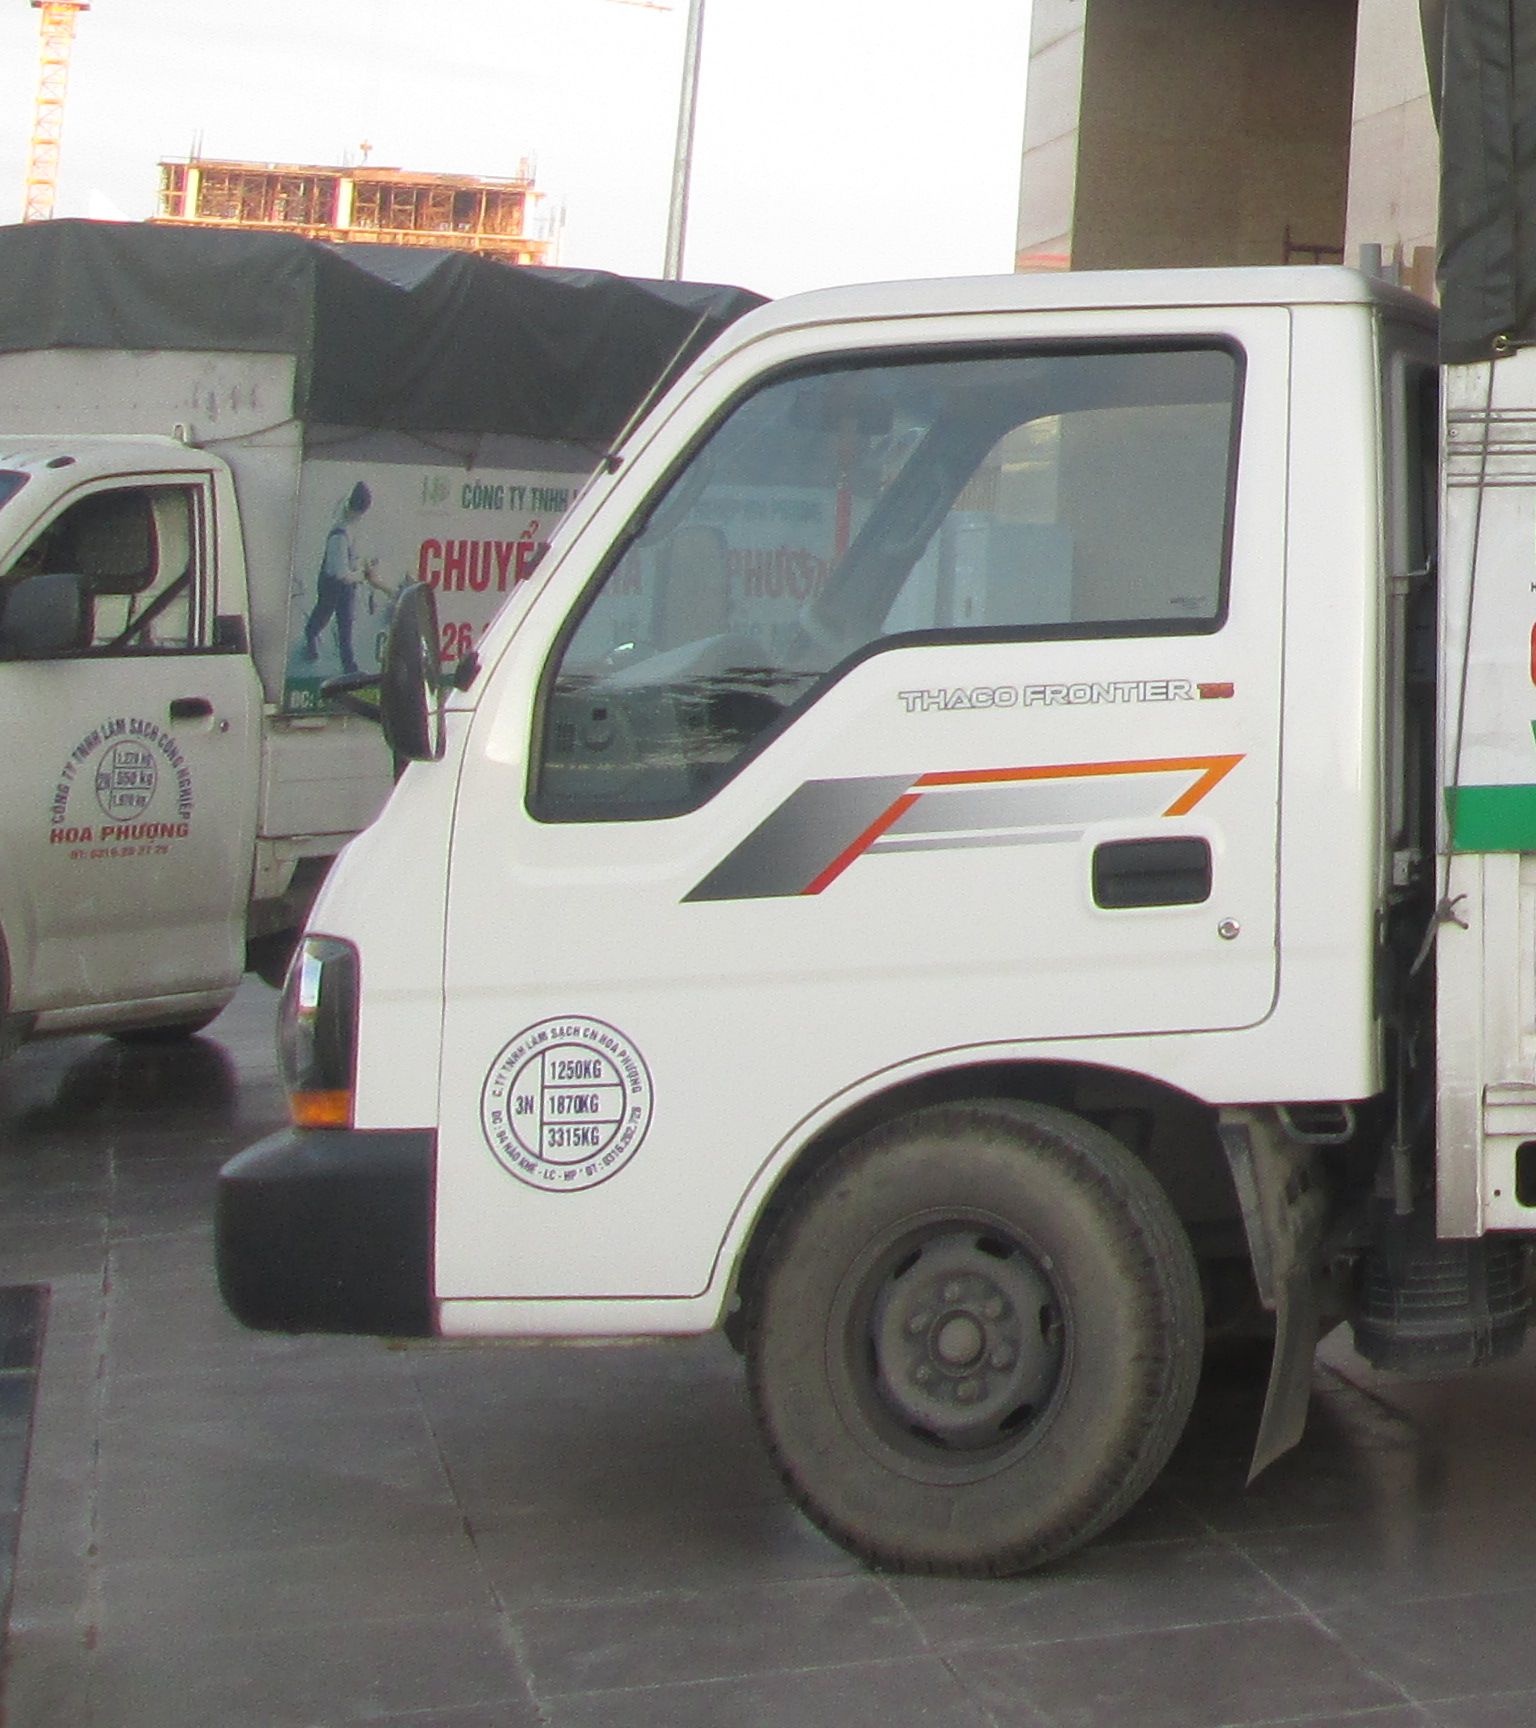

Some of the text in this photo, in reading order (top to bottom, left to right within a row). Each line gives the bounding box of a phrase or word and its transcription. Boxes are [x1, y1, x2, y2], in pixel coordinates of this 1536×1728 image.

[462, 478, 505, 511] CÔNG
[510, 486, 527, 511] TY
[531, 487, 569, 513] TNHH
[899, 685, 1019, 713] THACO
[1023, 679, 1196, 708] FRONTIER
[50, 822, 190, 845] HOA PHƯỢNG
[550, 1025, 582, 1040] SẠCH
[582, 1027, 598, 1041] CN
[598, 1033, 620, 1054] HOA
[550, 1058, 603, 1080] 1250KG
[514, 1094, 535, 1116] 3N
[548, 1093, 600, 1115] 1870KG
[547, 1125, 600, 1148] 3315KG
